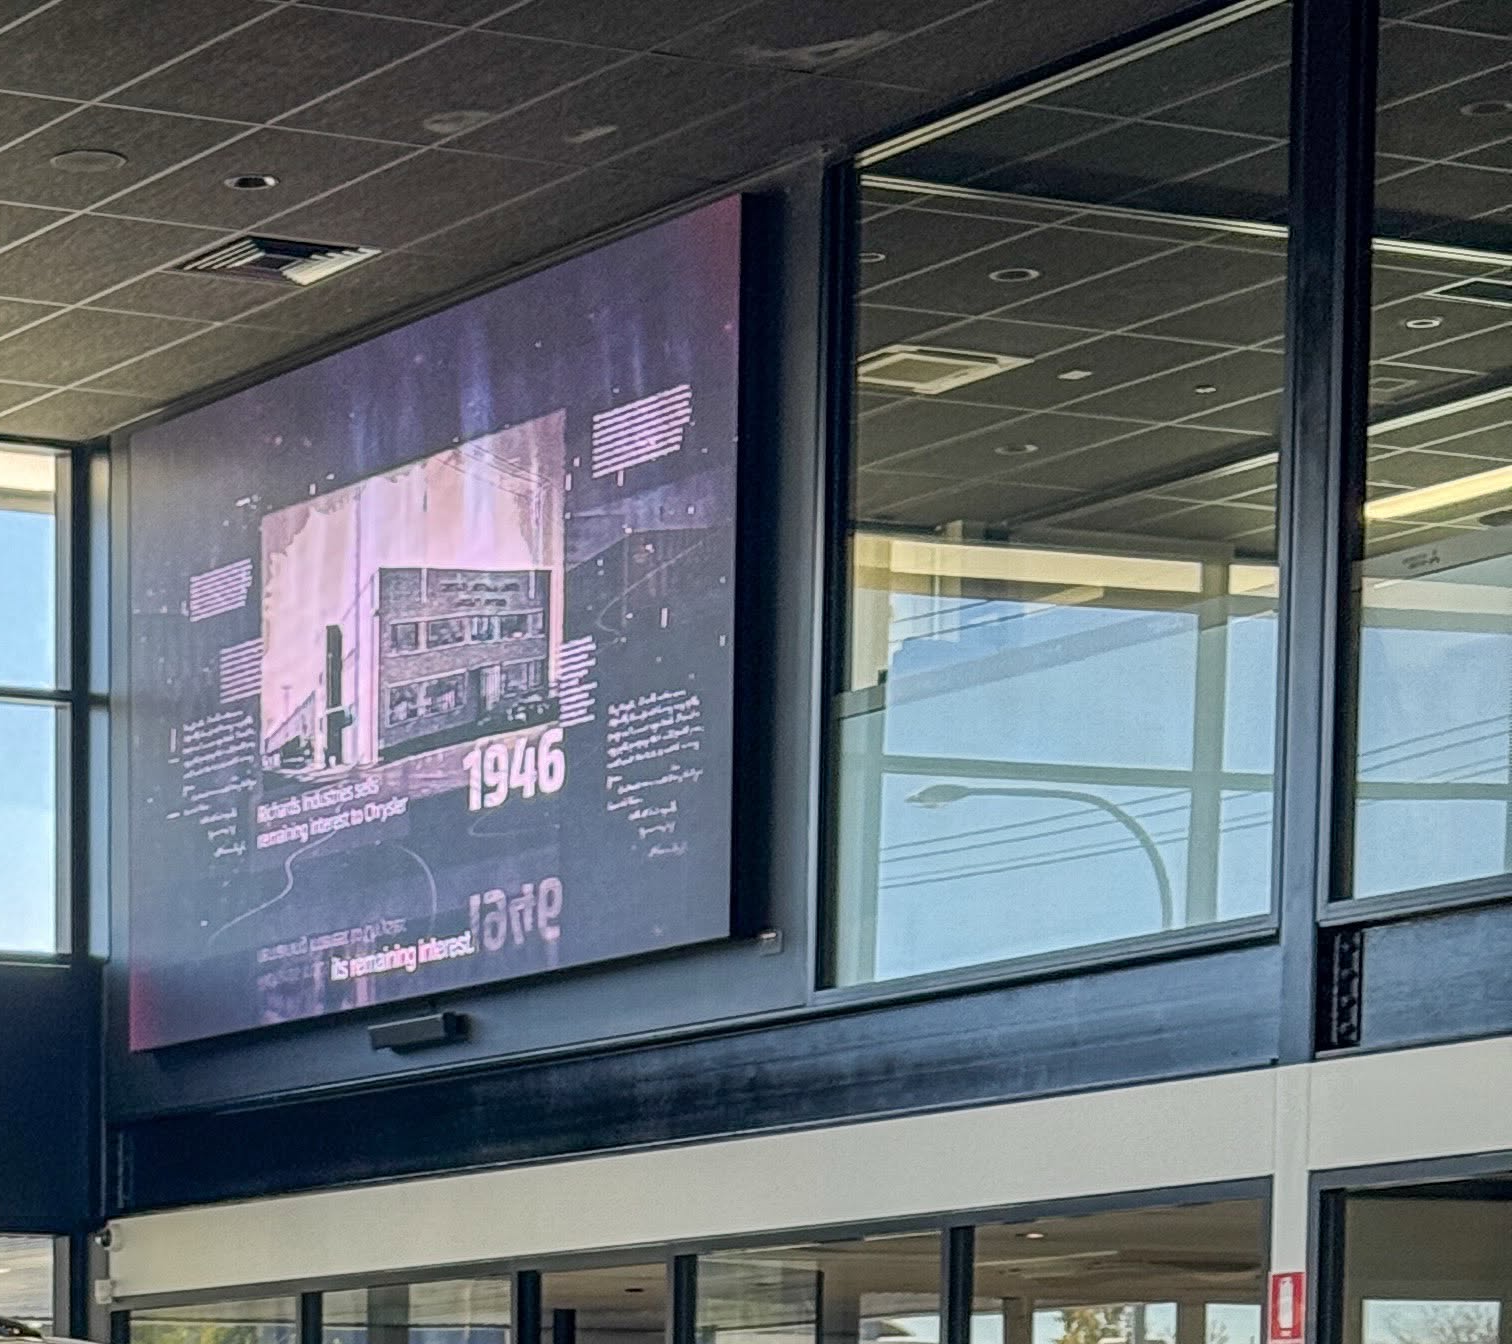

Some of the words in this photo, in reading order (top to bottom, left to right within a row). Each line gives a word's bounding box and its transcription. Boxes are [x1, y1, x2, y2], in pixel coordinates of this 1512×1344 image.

[463, 728, 565, 811] 1946
[330, 956, 349, 981] its
[349, 943, 417, 977] remaining
